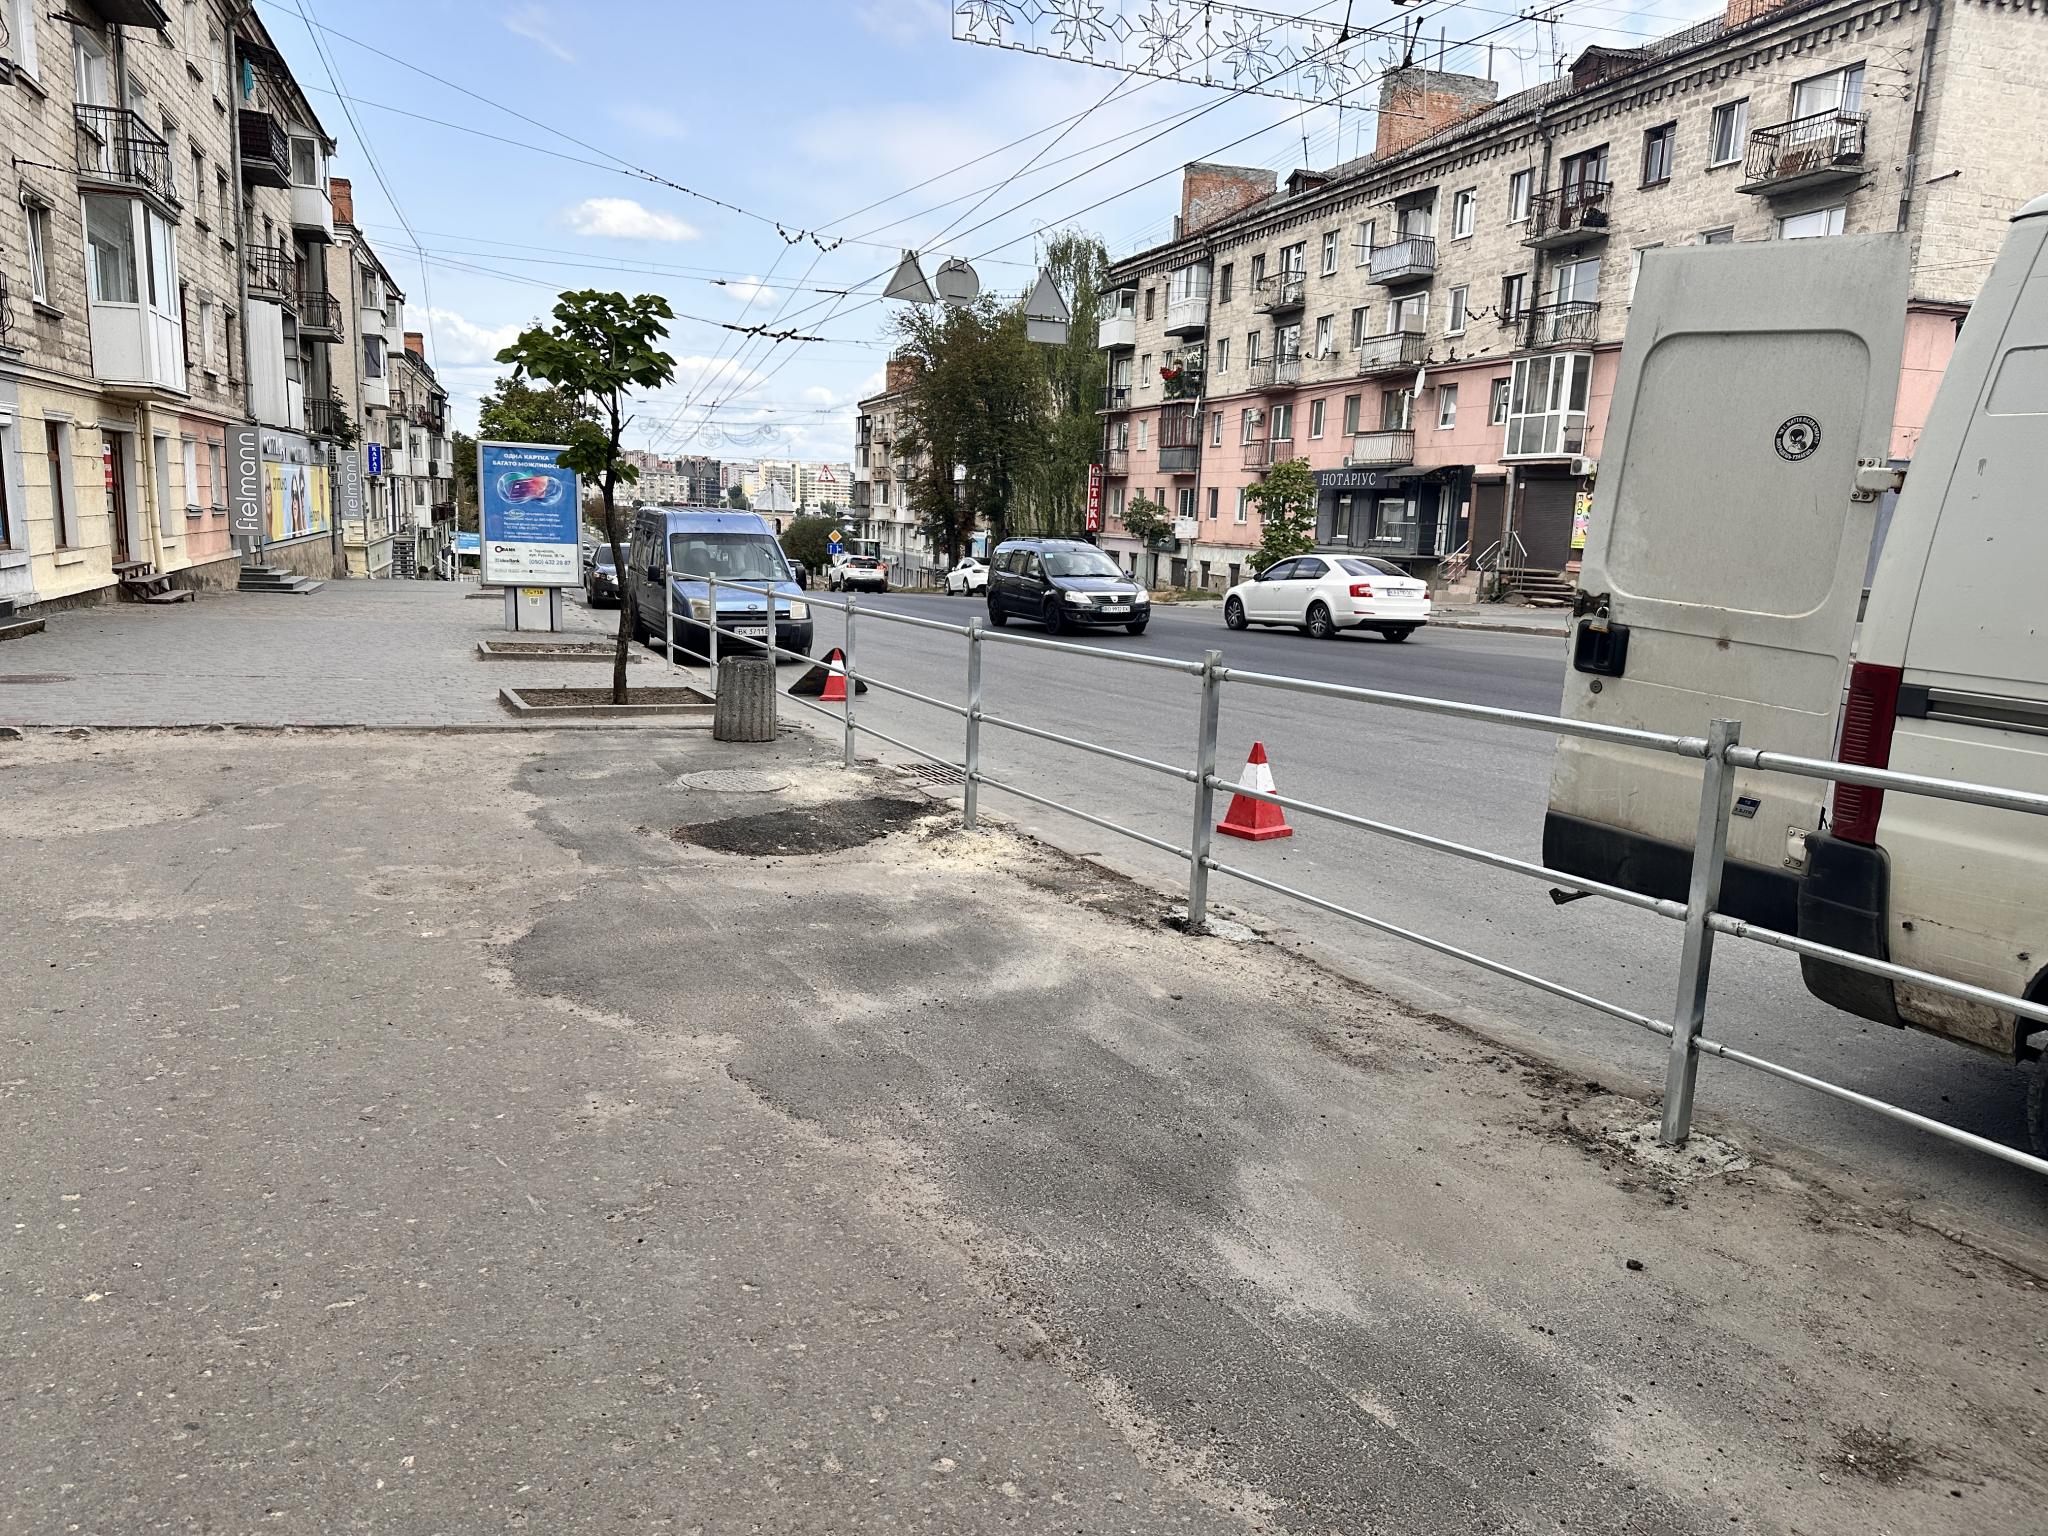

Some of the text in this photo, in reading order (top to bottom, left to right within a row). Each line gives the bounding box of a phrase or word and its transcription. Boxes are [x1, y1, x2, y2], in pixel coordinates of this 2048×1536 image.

[235, 432, 258, 530] fielmann
[344, 455, 359, 517] fielmann
[1088, 466, 1100, 529] ОПТИКА
[1321, 472, 1377, 486] НОТАРІУС
